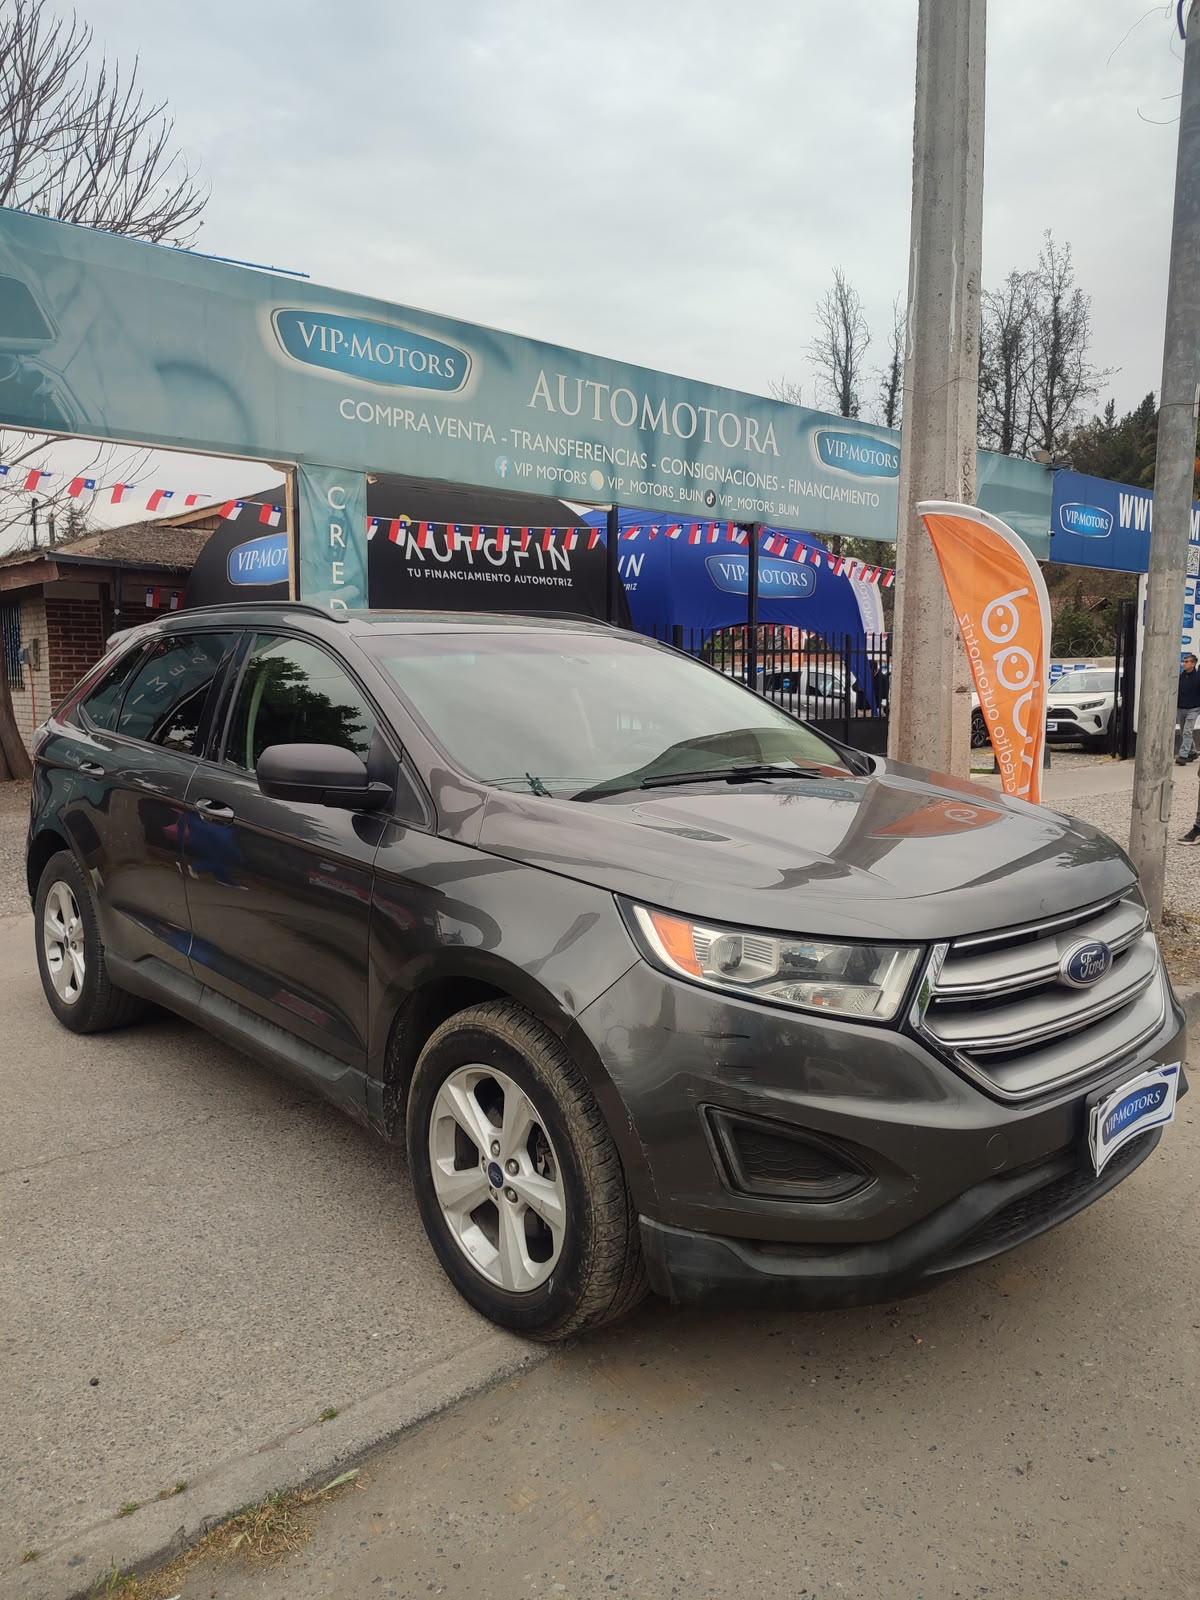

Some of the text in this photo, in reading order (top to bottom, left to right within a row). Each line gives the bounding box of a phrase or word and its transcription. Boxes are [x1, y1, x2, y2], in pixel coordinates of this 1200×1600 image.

[526, 368, 781, 457] AUTOMOTORA
[339, 398, 431, 434] COMPRA
[434, 415, 496, 445] VENTA
[510, 429, 647, 470] TRANSFERENCIAS
[661, 456, 778, 492] CONSIGNACIONES
[788, 479, 880, 508] FINANCIAMIENTO
[514, 461, 533, 477] VIP
[536, 466, 587, 485] MOTORS
[404, 531, 571, 571] AUTOFIN
[407, 568, 573, 587] TU FINANCIAMIENTO AUTOMOTRIZ
[1080, 949, 1106, 978] Ford
